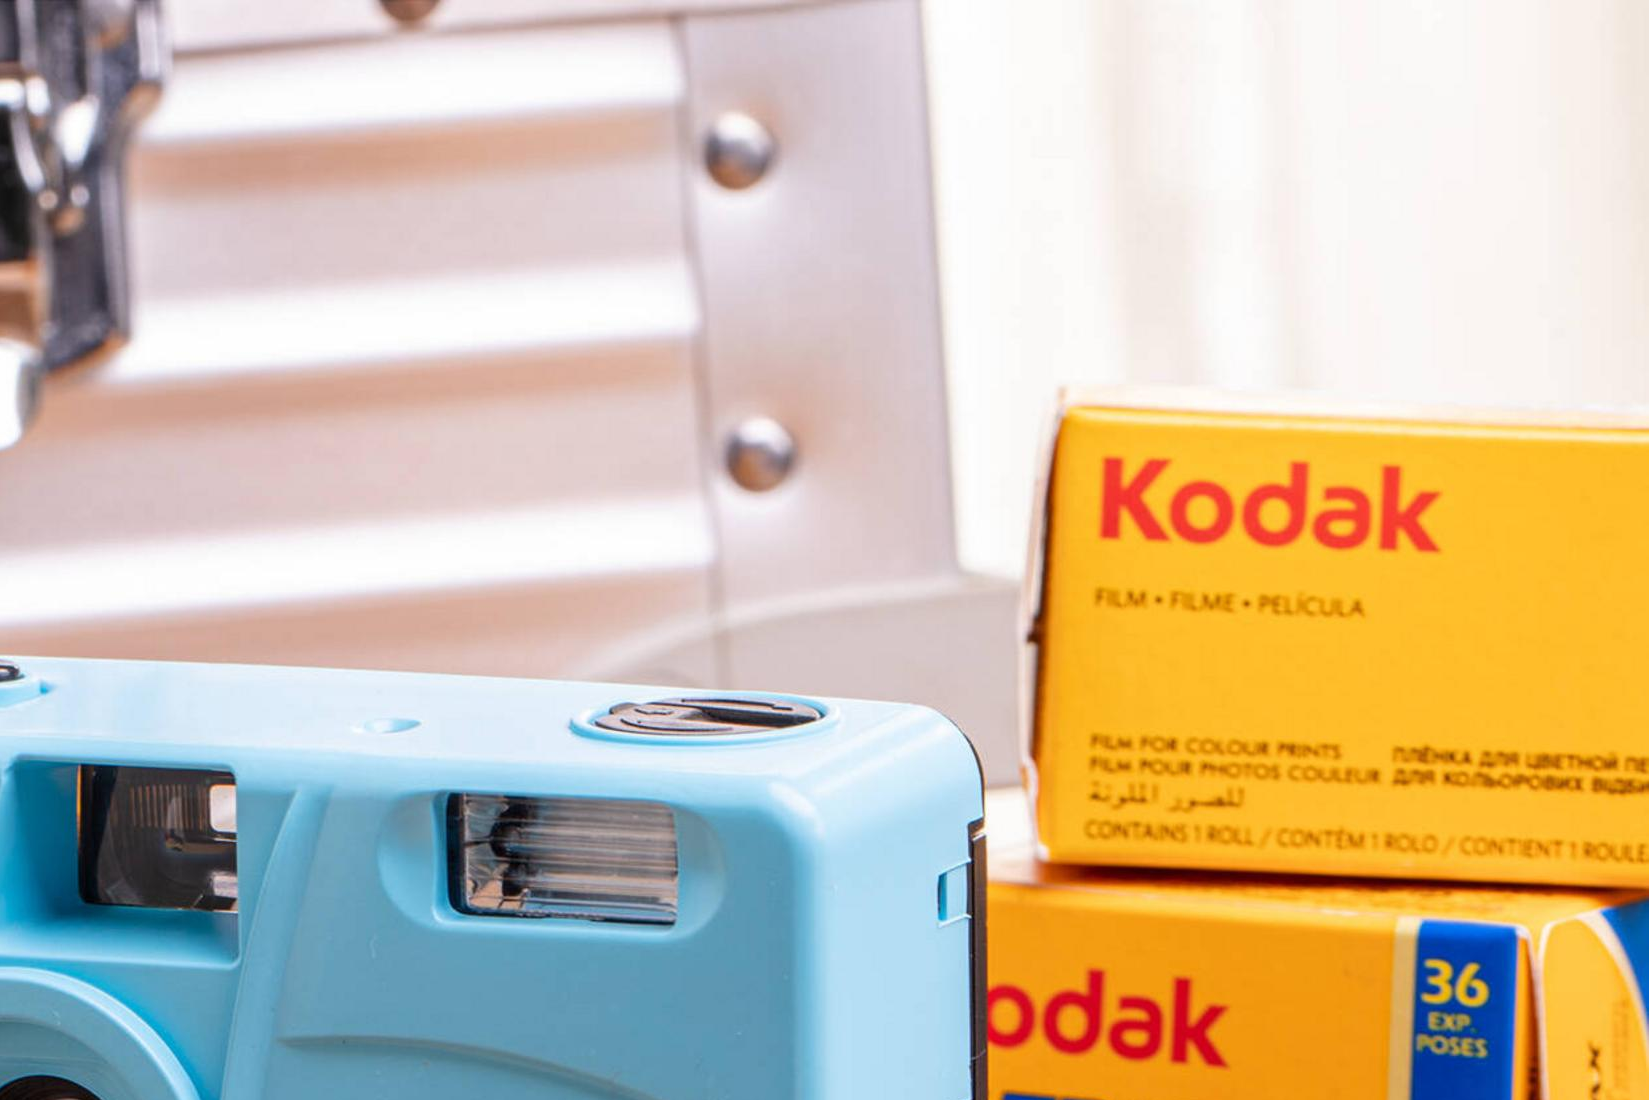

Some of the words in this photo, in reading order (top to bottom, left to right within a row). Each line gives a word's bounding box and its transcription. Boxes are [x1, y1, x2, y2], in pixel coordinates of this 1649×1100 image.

[1100, 456, 1443, 553] Kodak
[1094, 586, 1148, 610] FILM
[1168, 590, 1236, 613] FILME
[1257, 591, 1366, 618] PELÍCULA
[1089, 733, 1133, 751] FILM
[1140, 736, 1178, 754] FOR
[1185, 737, 1270, 757] COLOUR
[1277, 741, 1343, 761] PRINTS
[1089, 755, 1133, 774] FILM
[1140, 758, 1192, 777] POUR
[1200, 760, 1282, 781] PHOTOS
[1287, 764, 1380, 785] COULEUR
[1624, 755, 1649, 774] ПЕ
[1084, 819, 1188, 843] CONTAINS
[1206, 825, 1255, 847] ROLL
[1276, 825, 1366, 850] CONTÉM
[1384, 832, 1439, 854] ROLO
[1459, 835, 1564, 860] CONTIENT
[1582, 841, 1649, 864] ROULE
[1420, 958, 1490, 1008] 36
[987, 969, 1230, 1068] odak
[1427, 1011, 1479, 1034] EXP.
[1416, 1033, 1488, 1059] POSES
